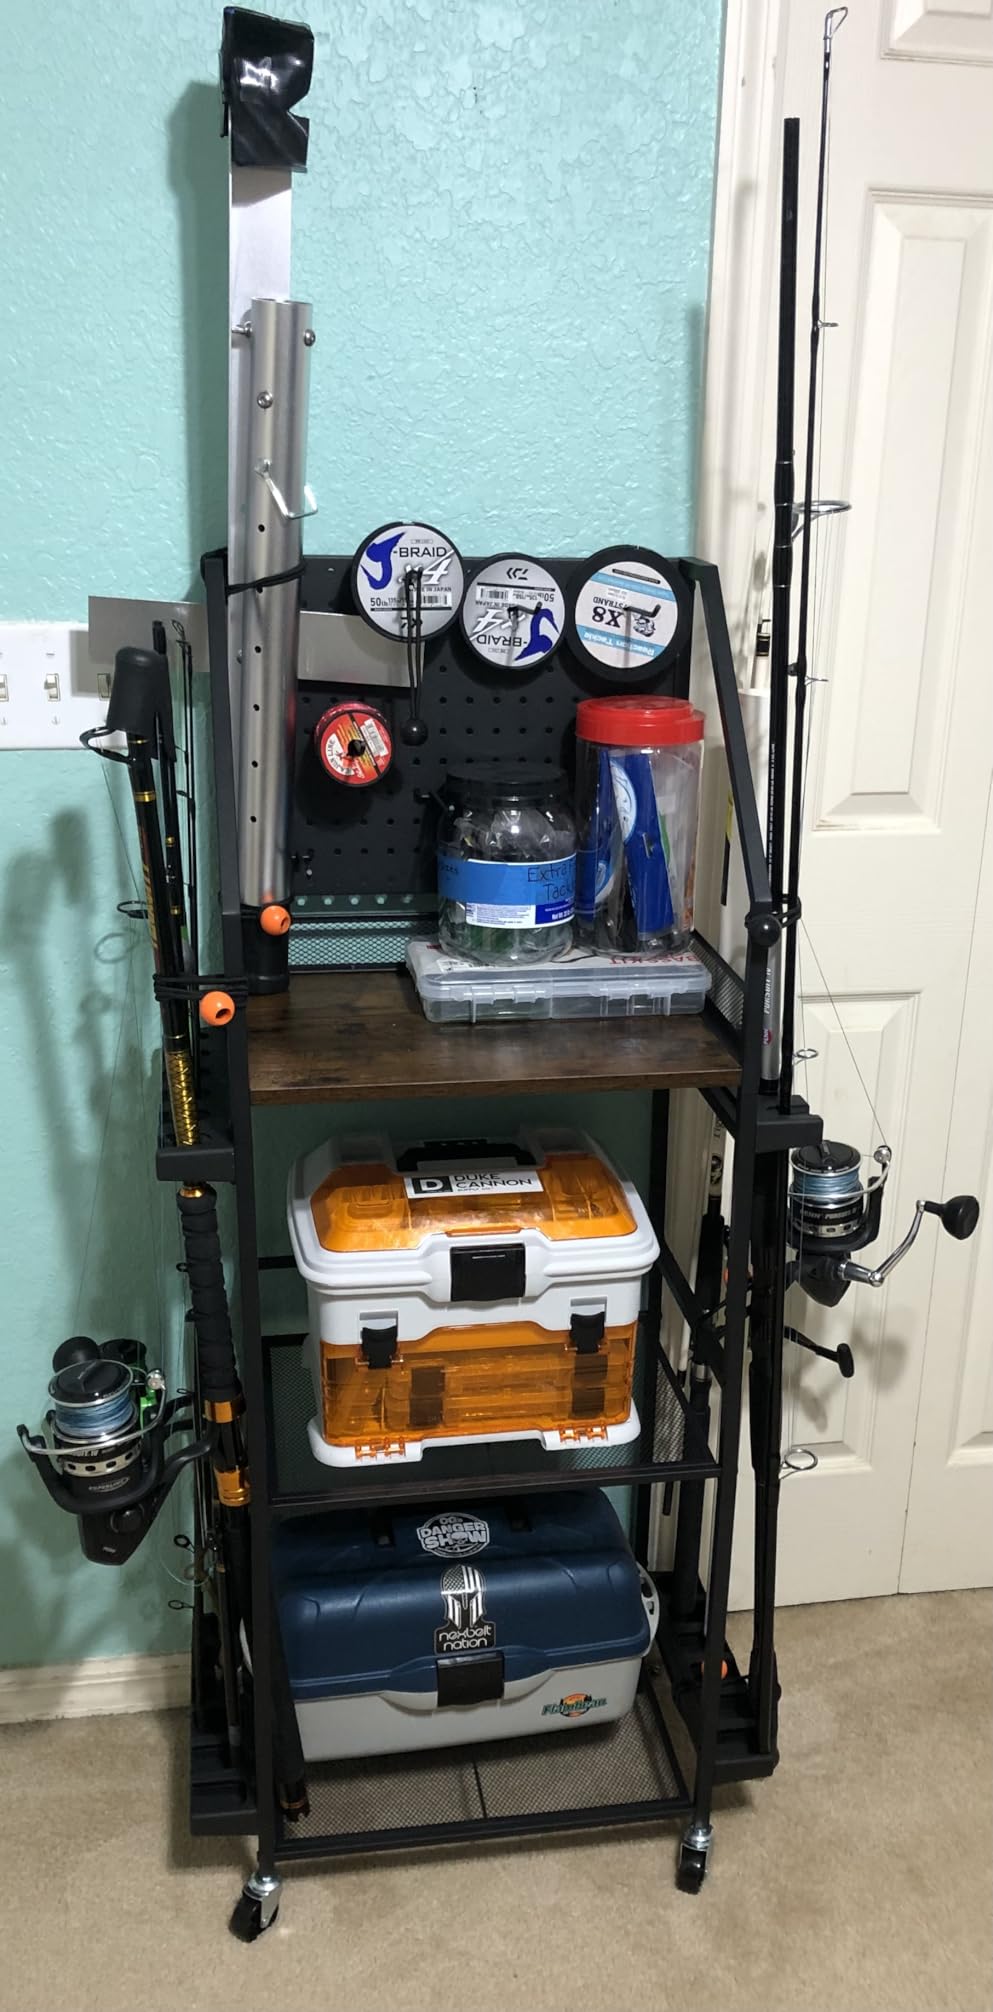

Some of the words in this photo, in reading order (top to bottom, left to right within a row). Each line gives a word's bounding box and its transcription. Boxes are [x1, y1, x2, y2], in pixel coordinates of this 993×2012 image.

[592, 596, 624, 609] STRAND
[592, 606, 625, 628] X8
[454, 1173, 501, 1181] DUKE
[455, 1178, 532, 1189] CANNON
[419, 1178, 444, 1191] D
[420, 1521, 486, 1538] DANGER
[439, 1625, 492, 1641] nexbelt
[443, 1637, 488, 1651] nation
